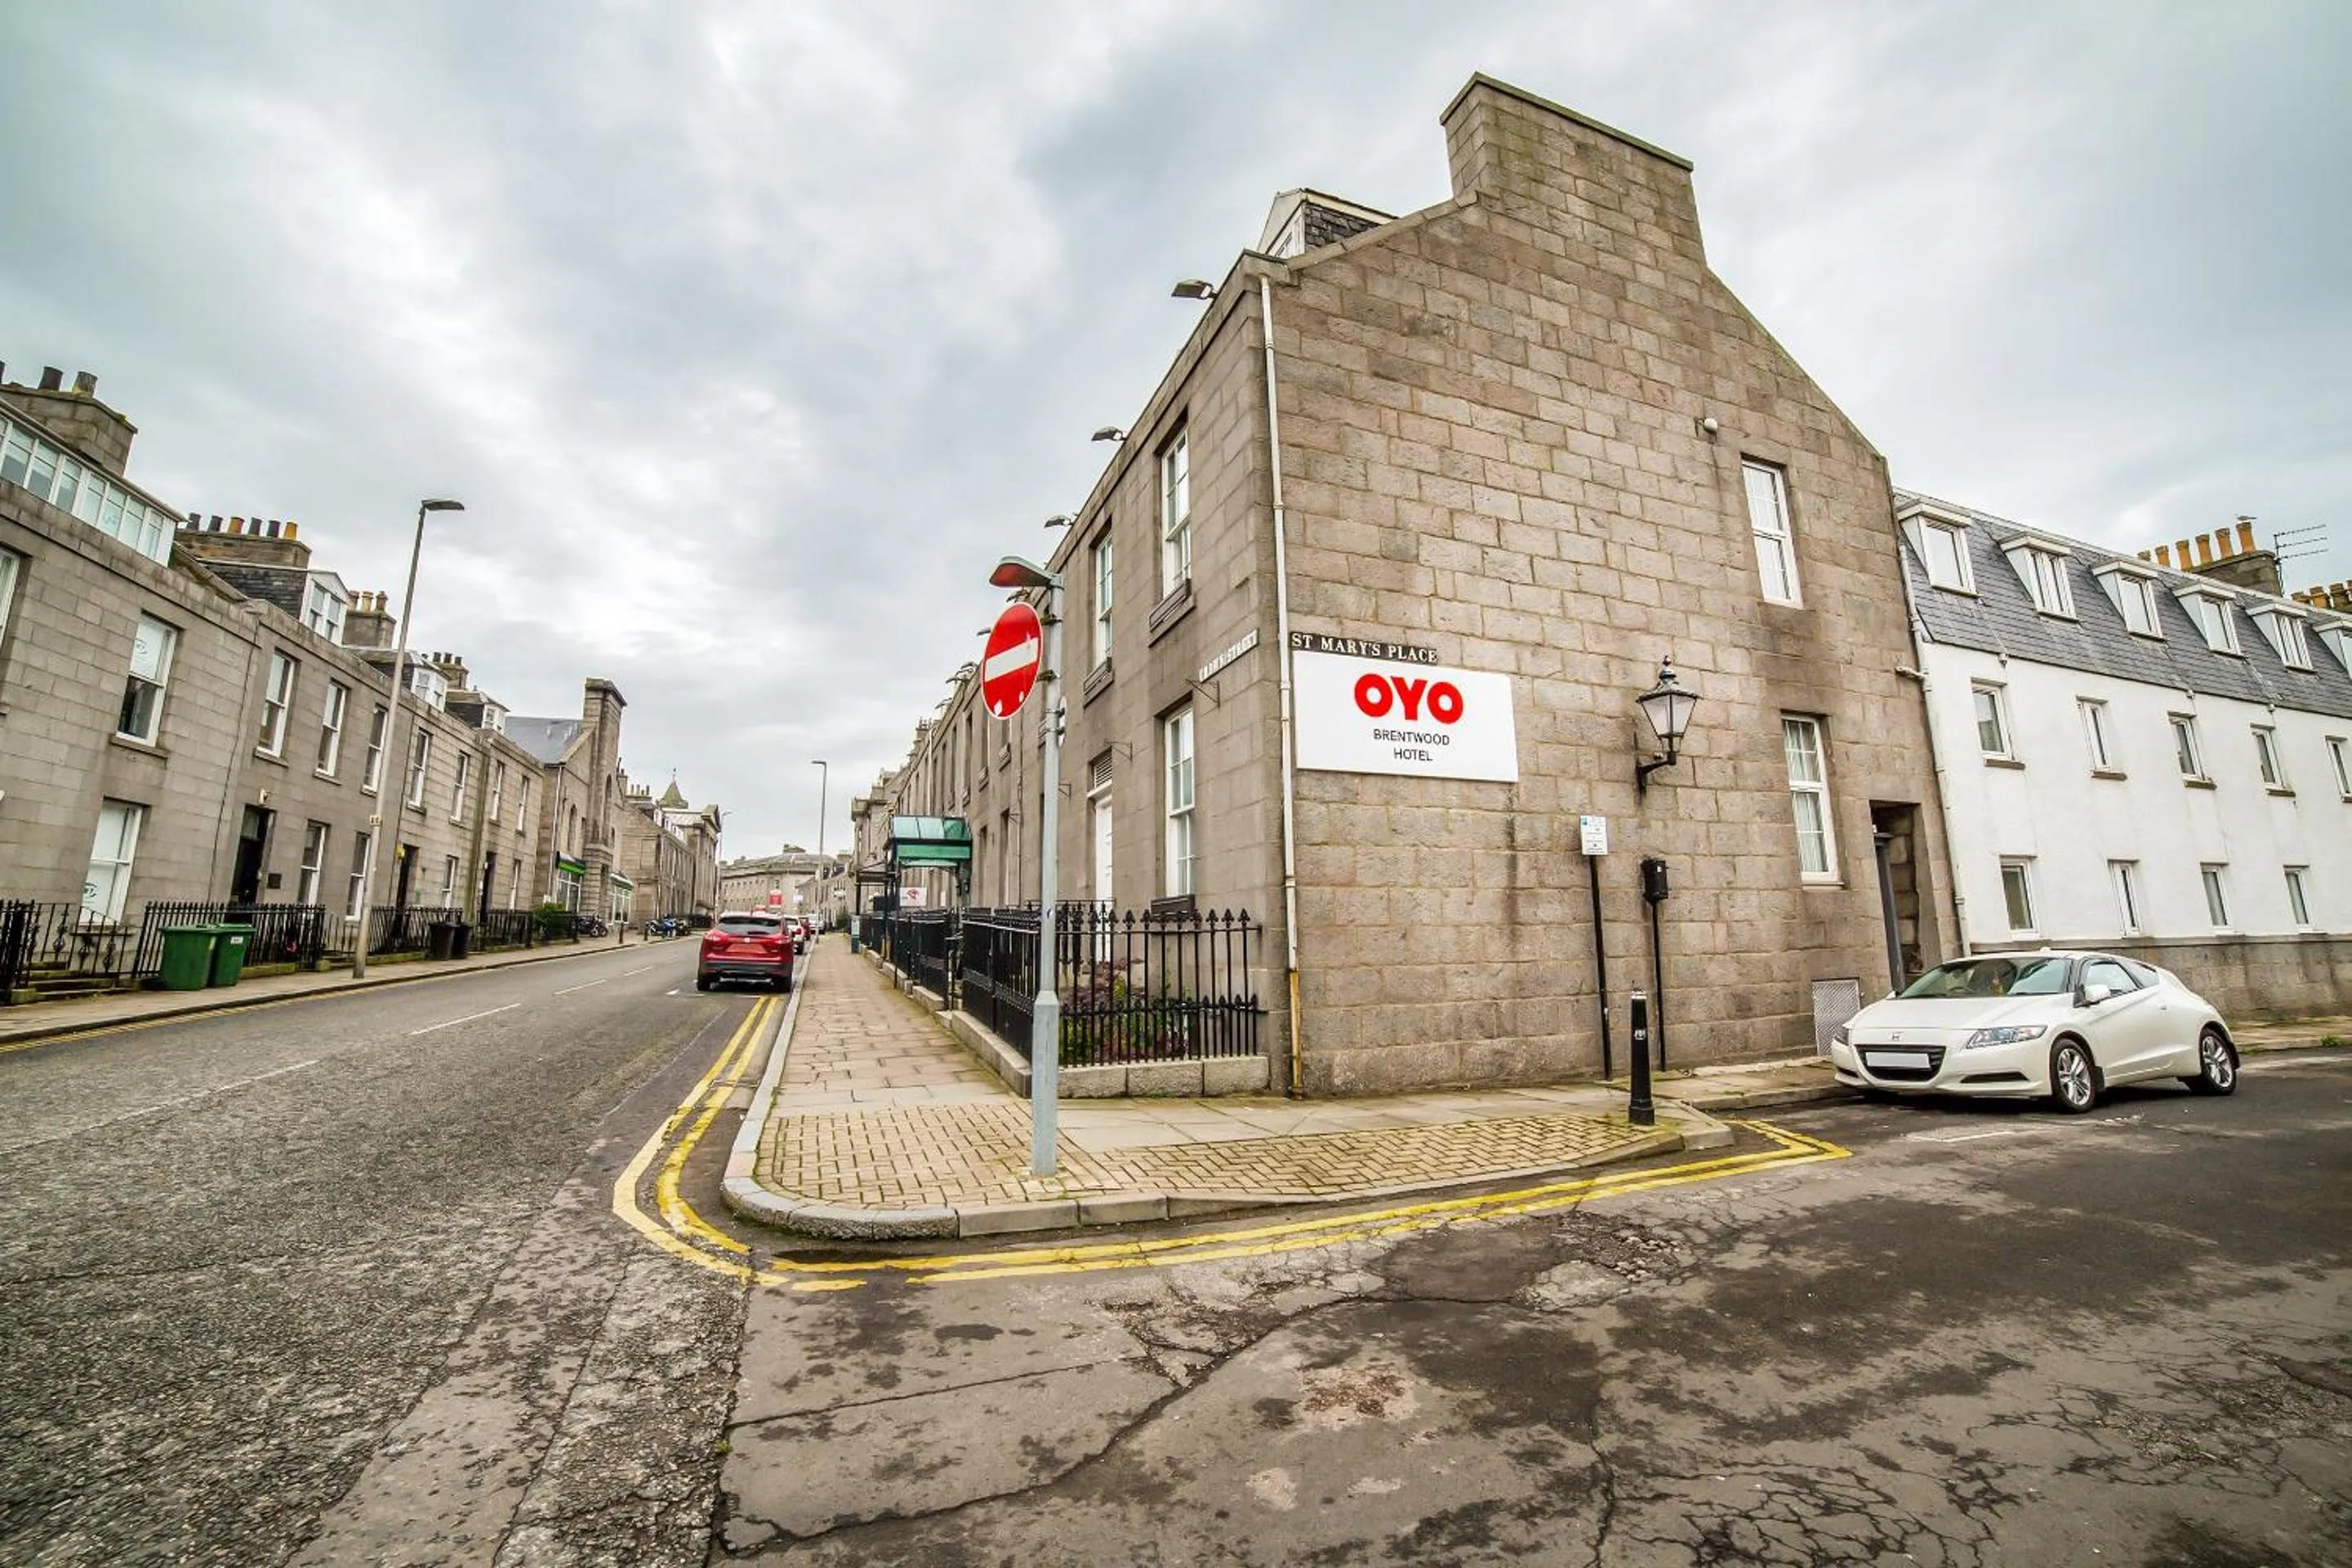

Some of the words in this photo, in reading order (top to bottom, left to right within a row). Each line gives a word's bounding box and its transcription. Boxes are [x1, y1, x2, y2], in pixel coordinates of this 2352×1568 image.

[1292, 633, 1313, 648] ST
[1321, 637, 1380, 656] MARY'S
[1388, 646, 1437, 662] PLACE
[1354, 673, 1463, 724] OYO
[1373, 728, 1450, 746] BRENTWOOD
[1393, 748, 1433, 761] HOTEL
